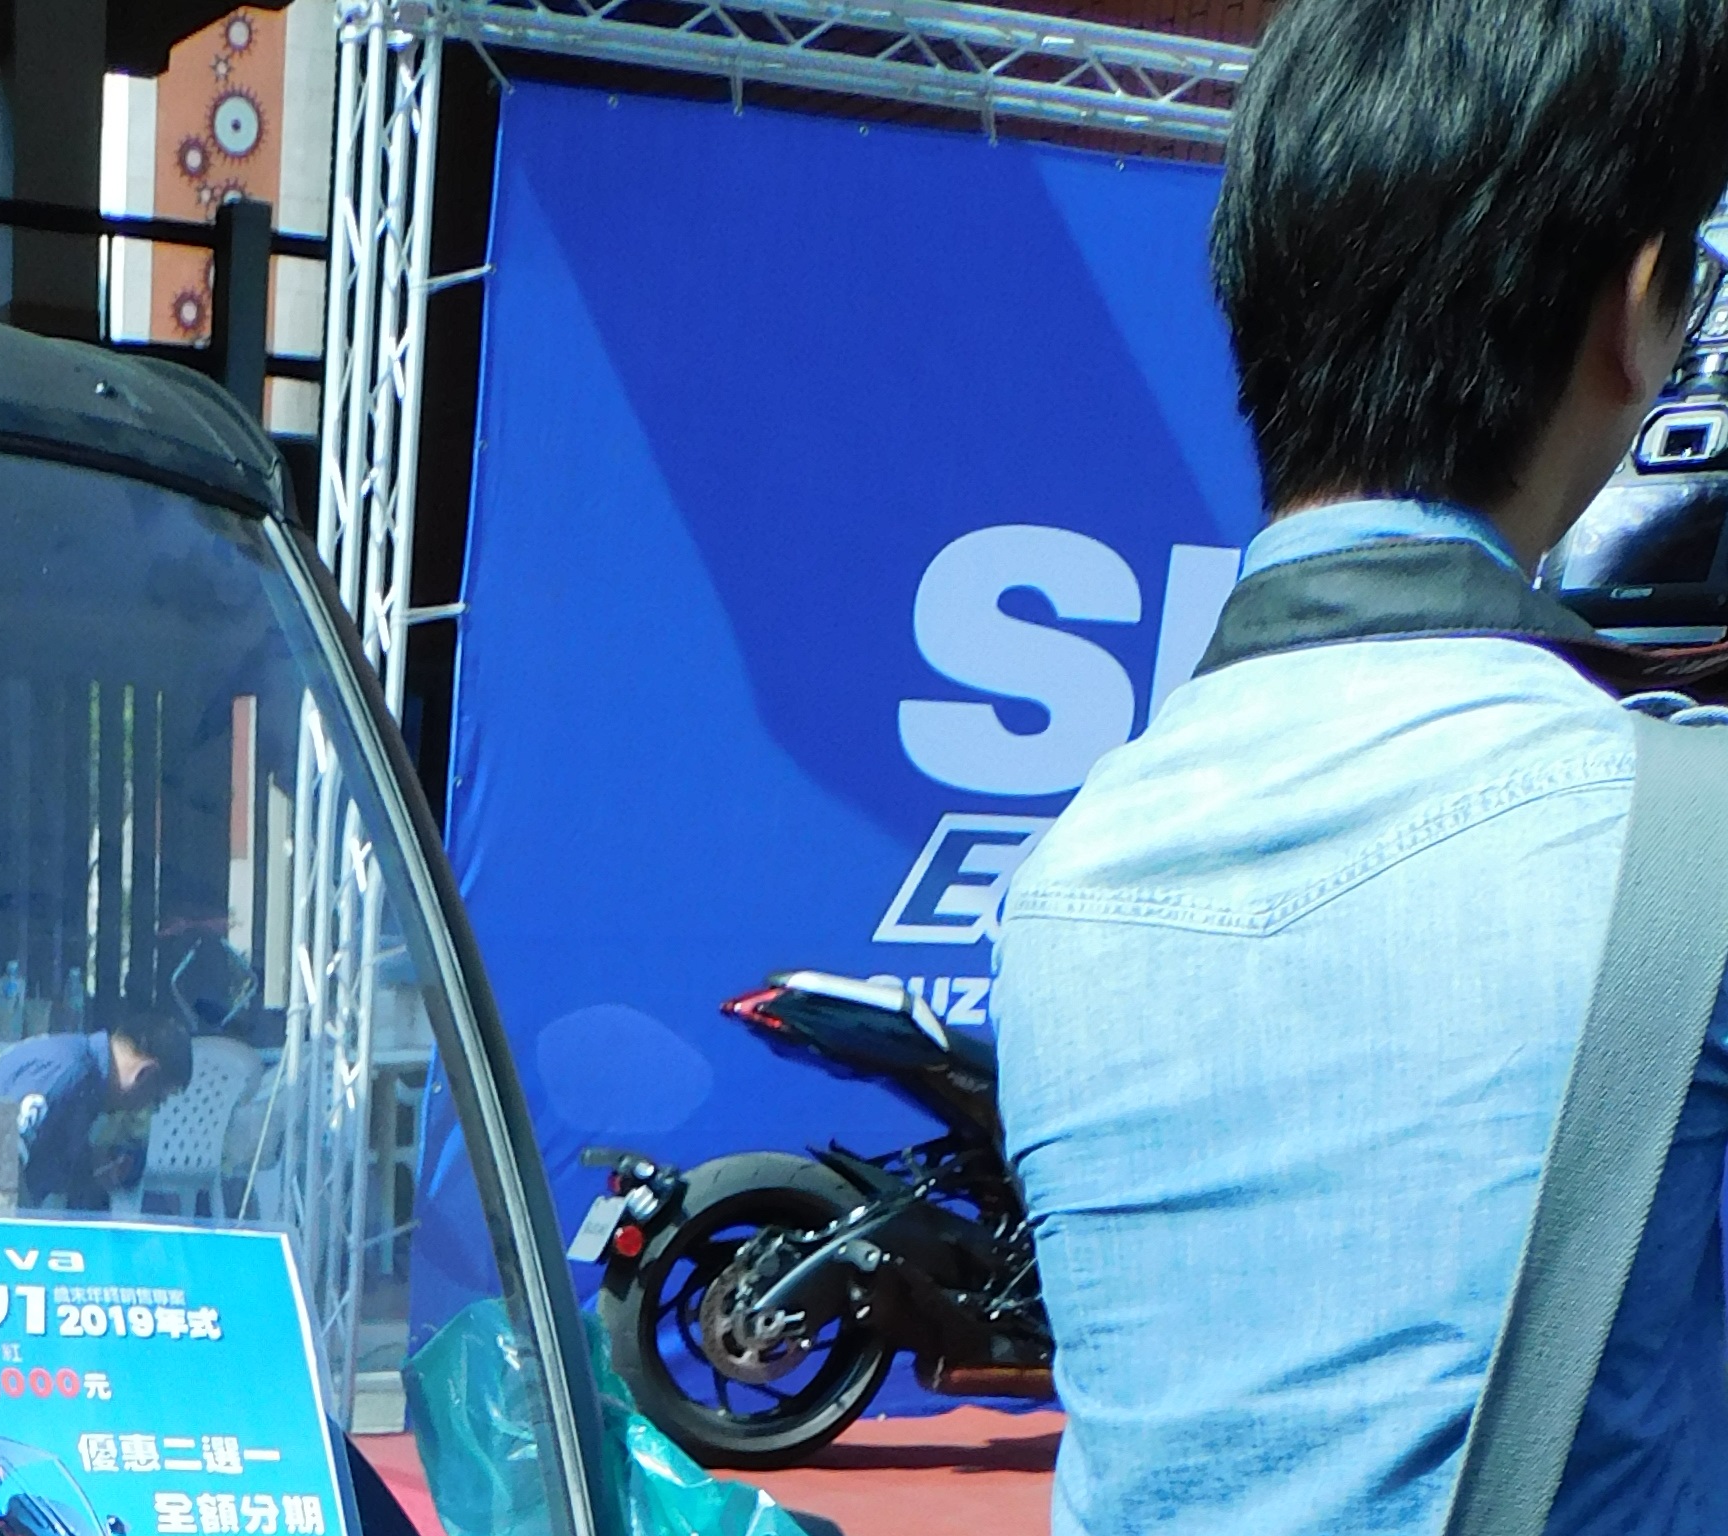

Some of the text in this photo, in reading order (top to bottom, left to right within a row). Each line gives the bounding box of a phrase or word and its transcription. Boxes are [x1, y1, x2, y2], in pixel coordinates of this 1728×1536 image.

[873, 813, 1059, 943] E
[56, 1303, 223, 1341] 2019年式
[78, 1433, 280, 1475] 優惠二選一
[153, 1492, 325, 1535] 全額分期
